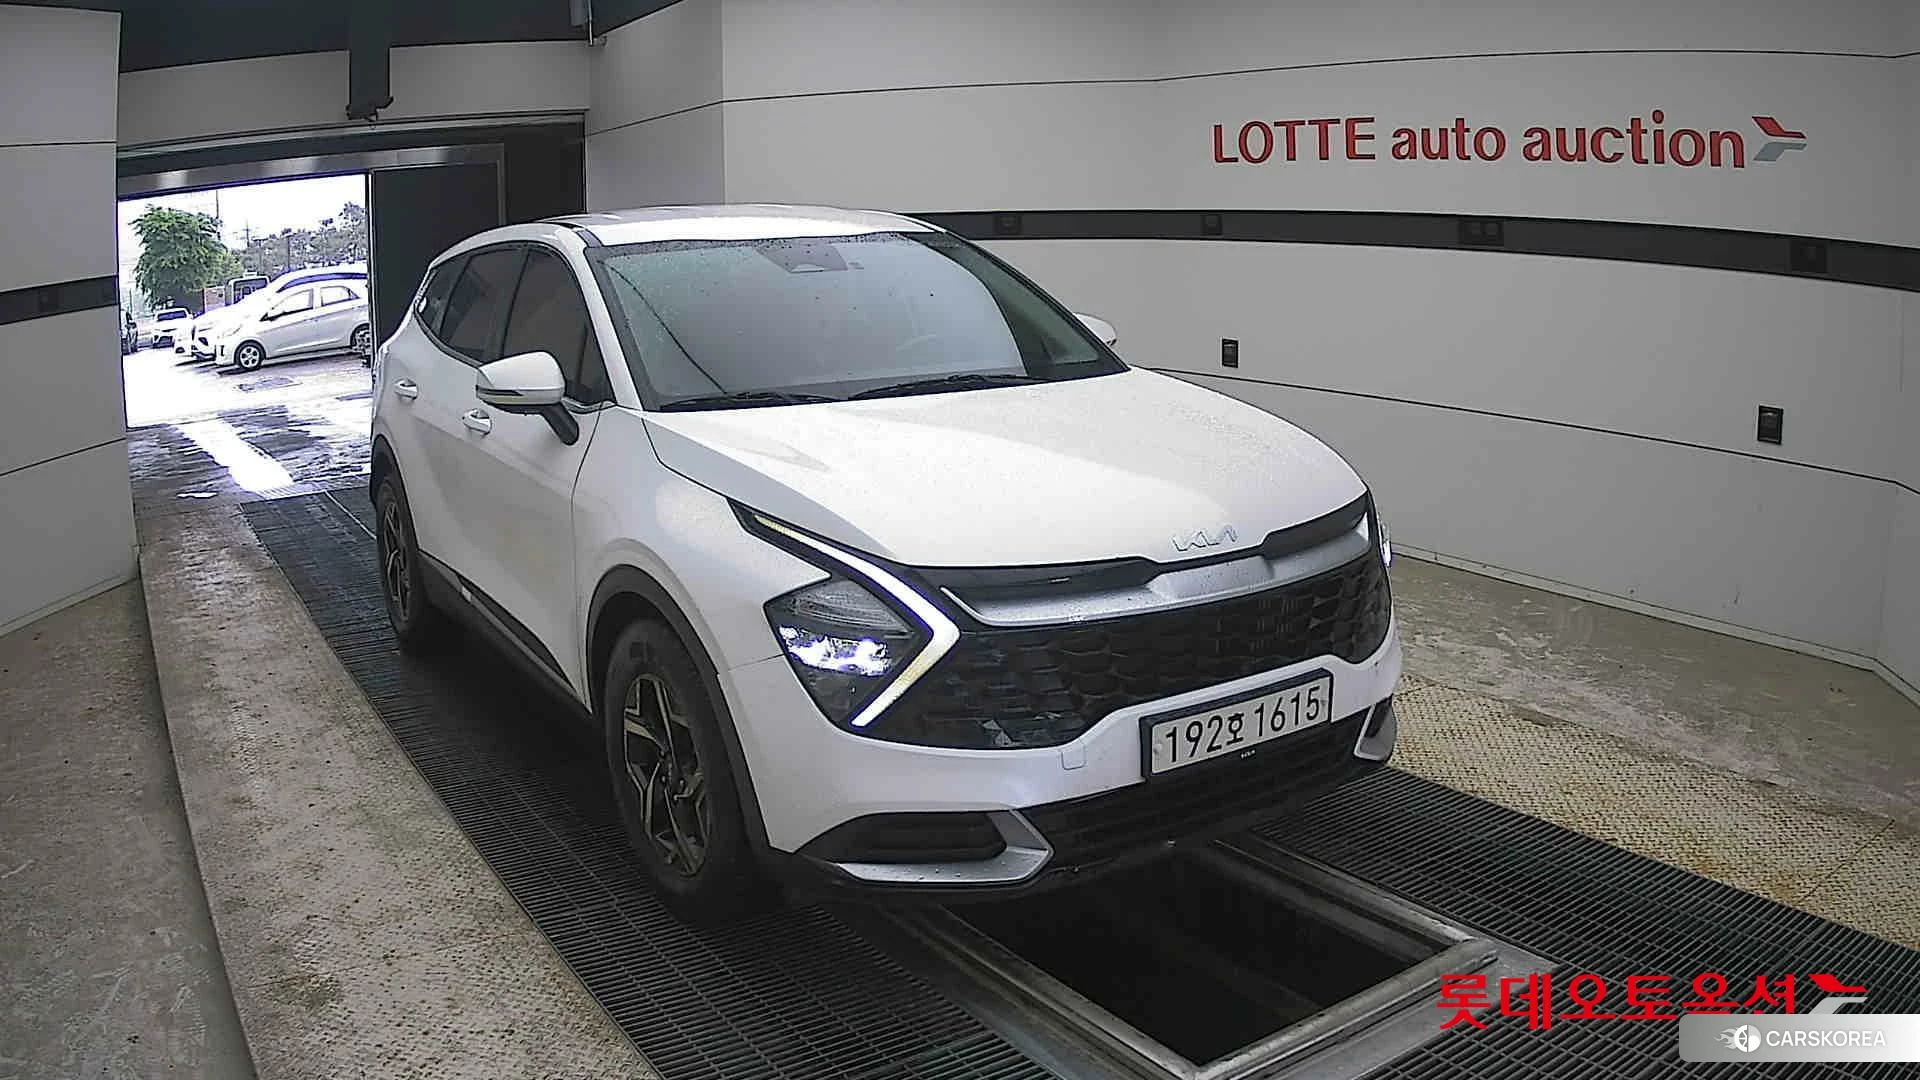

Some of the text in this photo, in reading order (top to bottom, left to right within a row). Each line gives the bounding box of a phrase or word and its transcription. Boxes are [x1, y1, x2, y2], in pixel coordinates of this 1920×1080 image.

[1213, 109, 1745, 168] LOTTE auto auction
[1165, 685, 1321, 763] 192호 1615
